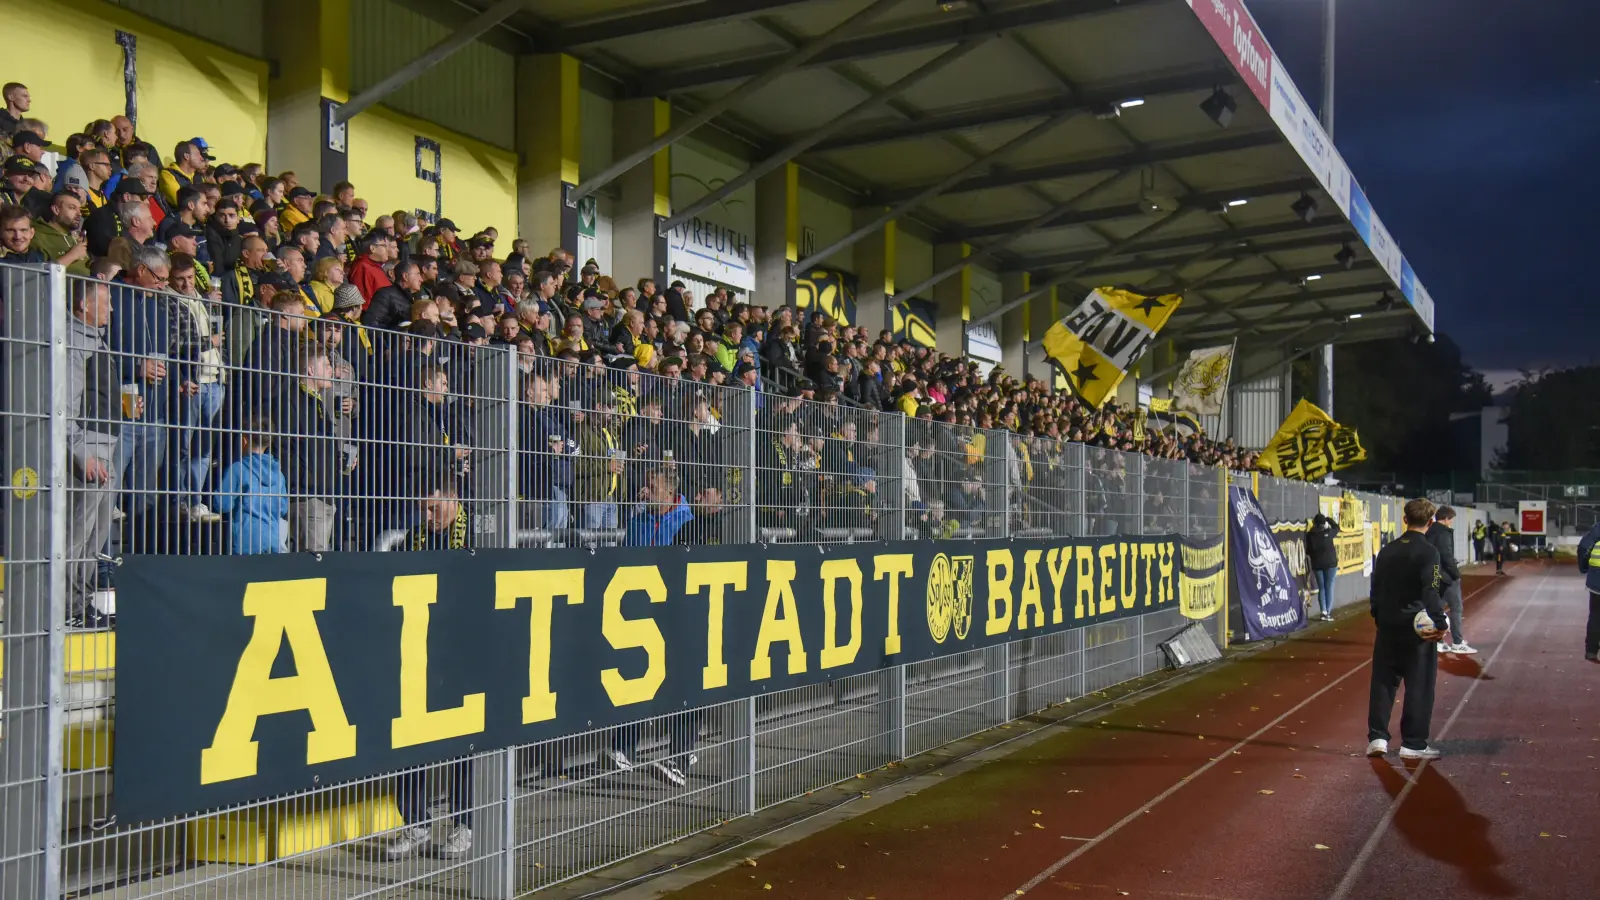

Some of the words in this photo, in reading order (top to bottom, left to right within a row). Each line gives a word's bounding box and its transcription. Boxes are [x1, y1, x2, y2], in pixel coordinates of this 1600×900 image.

[1233, 8, 1268, 90] Topform!
[414, 134, 441, 224] 9
[200, 553, 914, 785] ALTSTADT
[985, 541, 1176, 636] BAYREUTH
